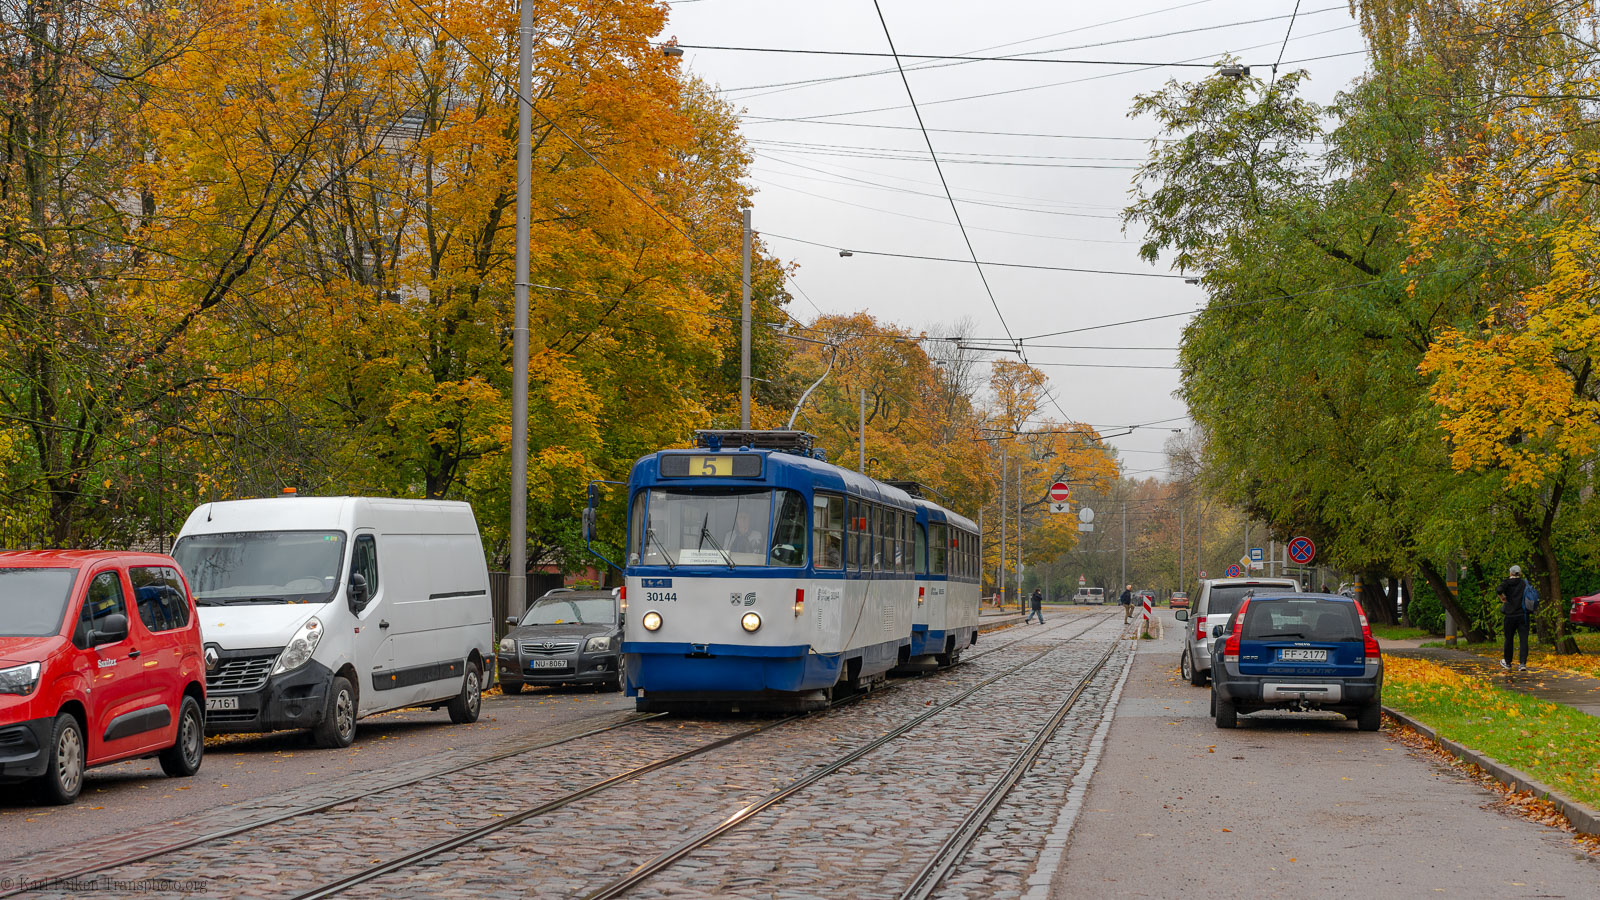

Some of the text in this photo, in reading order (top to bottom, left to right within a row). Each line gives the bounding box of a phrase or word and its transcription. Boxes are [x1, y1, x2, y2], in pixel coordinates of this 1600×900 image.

[702, 457, 717, 476] 5
[646, 592, 678, 602] 30144
[1284, 650, 1326, 658] FF-2177
